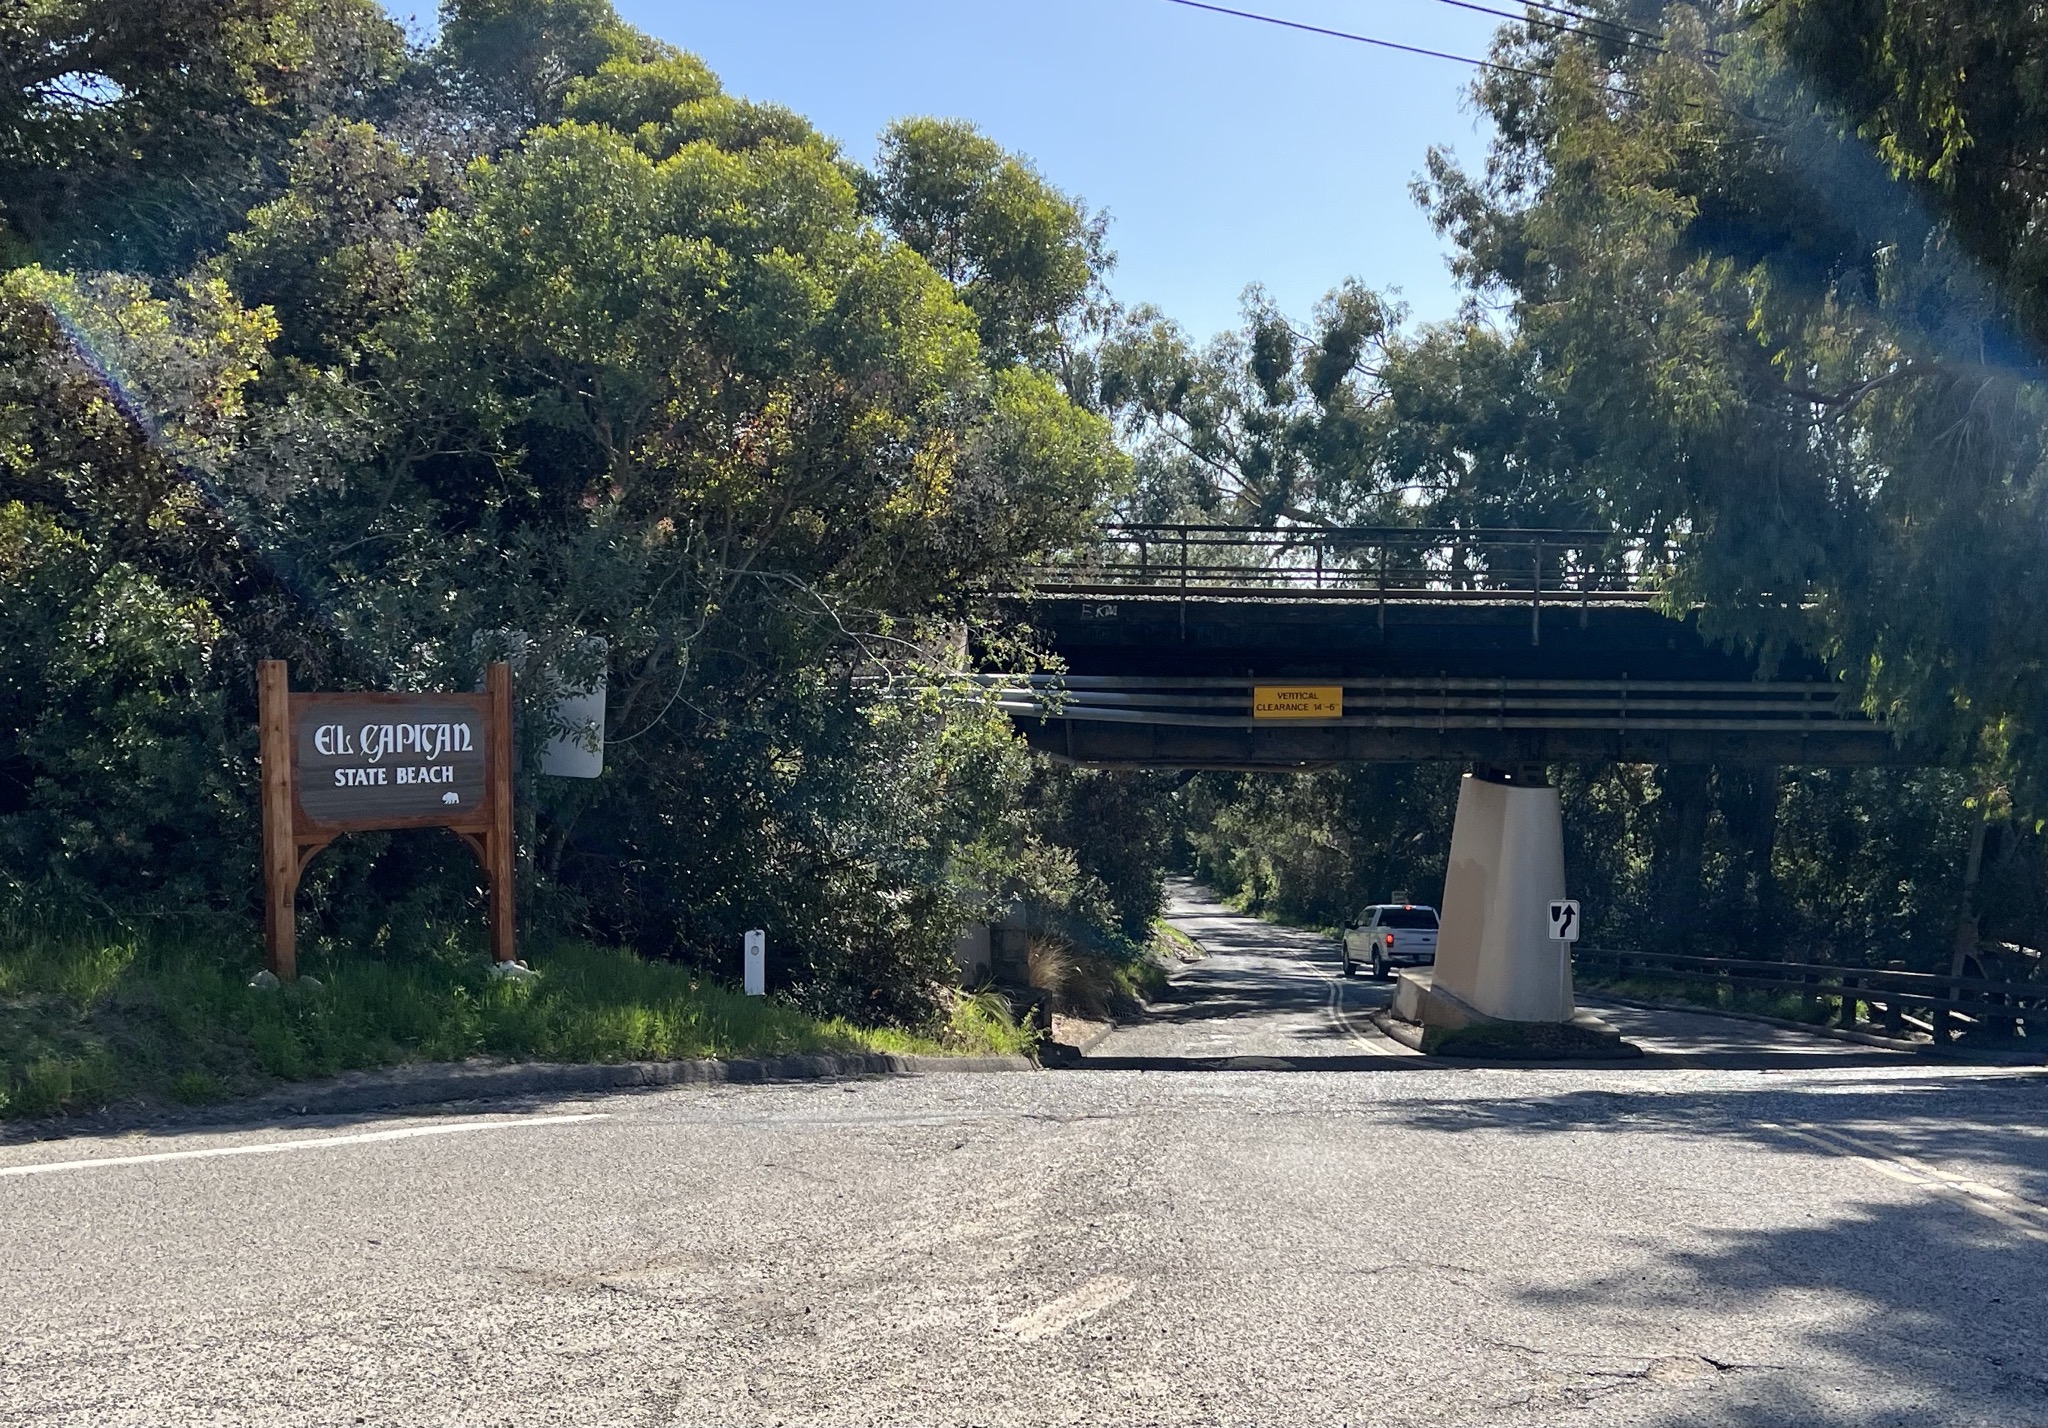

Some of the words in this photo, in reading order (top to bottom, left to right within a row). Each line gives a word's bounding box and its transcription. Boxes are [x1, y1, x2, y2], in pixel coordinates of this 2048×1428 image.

[1277, 692, 1319, 700] VERTICAL
[1256, 703, 1309, 711] CLEARANCE
[314, 724, 354, 756] EL
[359, 722, 474, 764] CAPITAN
[334, 767, 388, 787] STATE
[396, 766, 454, 785] BEACH
